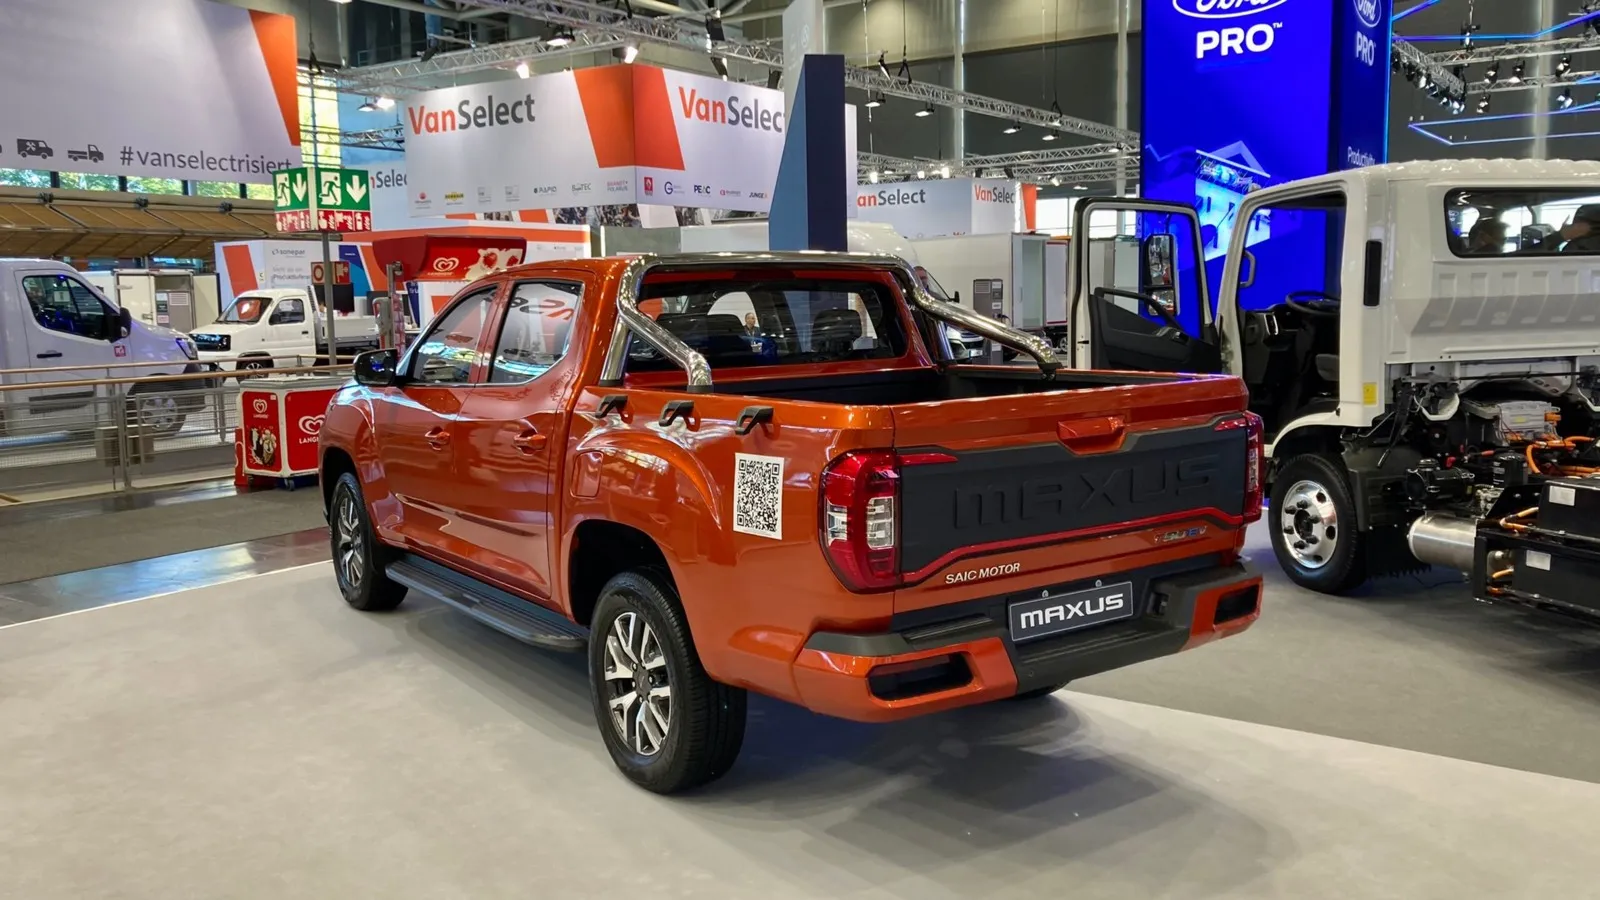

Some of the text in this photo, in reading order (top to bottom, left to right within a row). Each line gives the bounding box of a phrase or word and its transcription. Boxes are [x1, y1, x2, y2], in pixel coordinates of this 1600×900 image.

[408, 93, 536, 135] VanSelect
[678, 86, 785, 133] VanSelec
[954, 453, 1220, 530] MAXUS
[945, 562, 1021, 584] SAIC MOTOR
[1020, 593, 1124, 629] MAXUS
